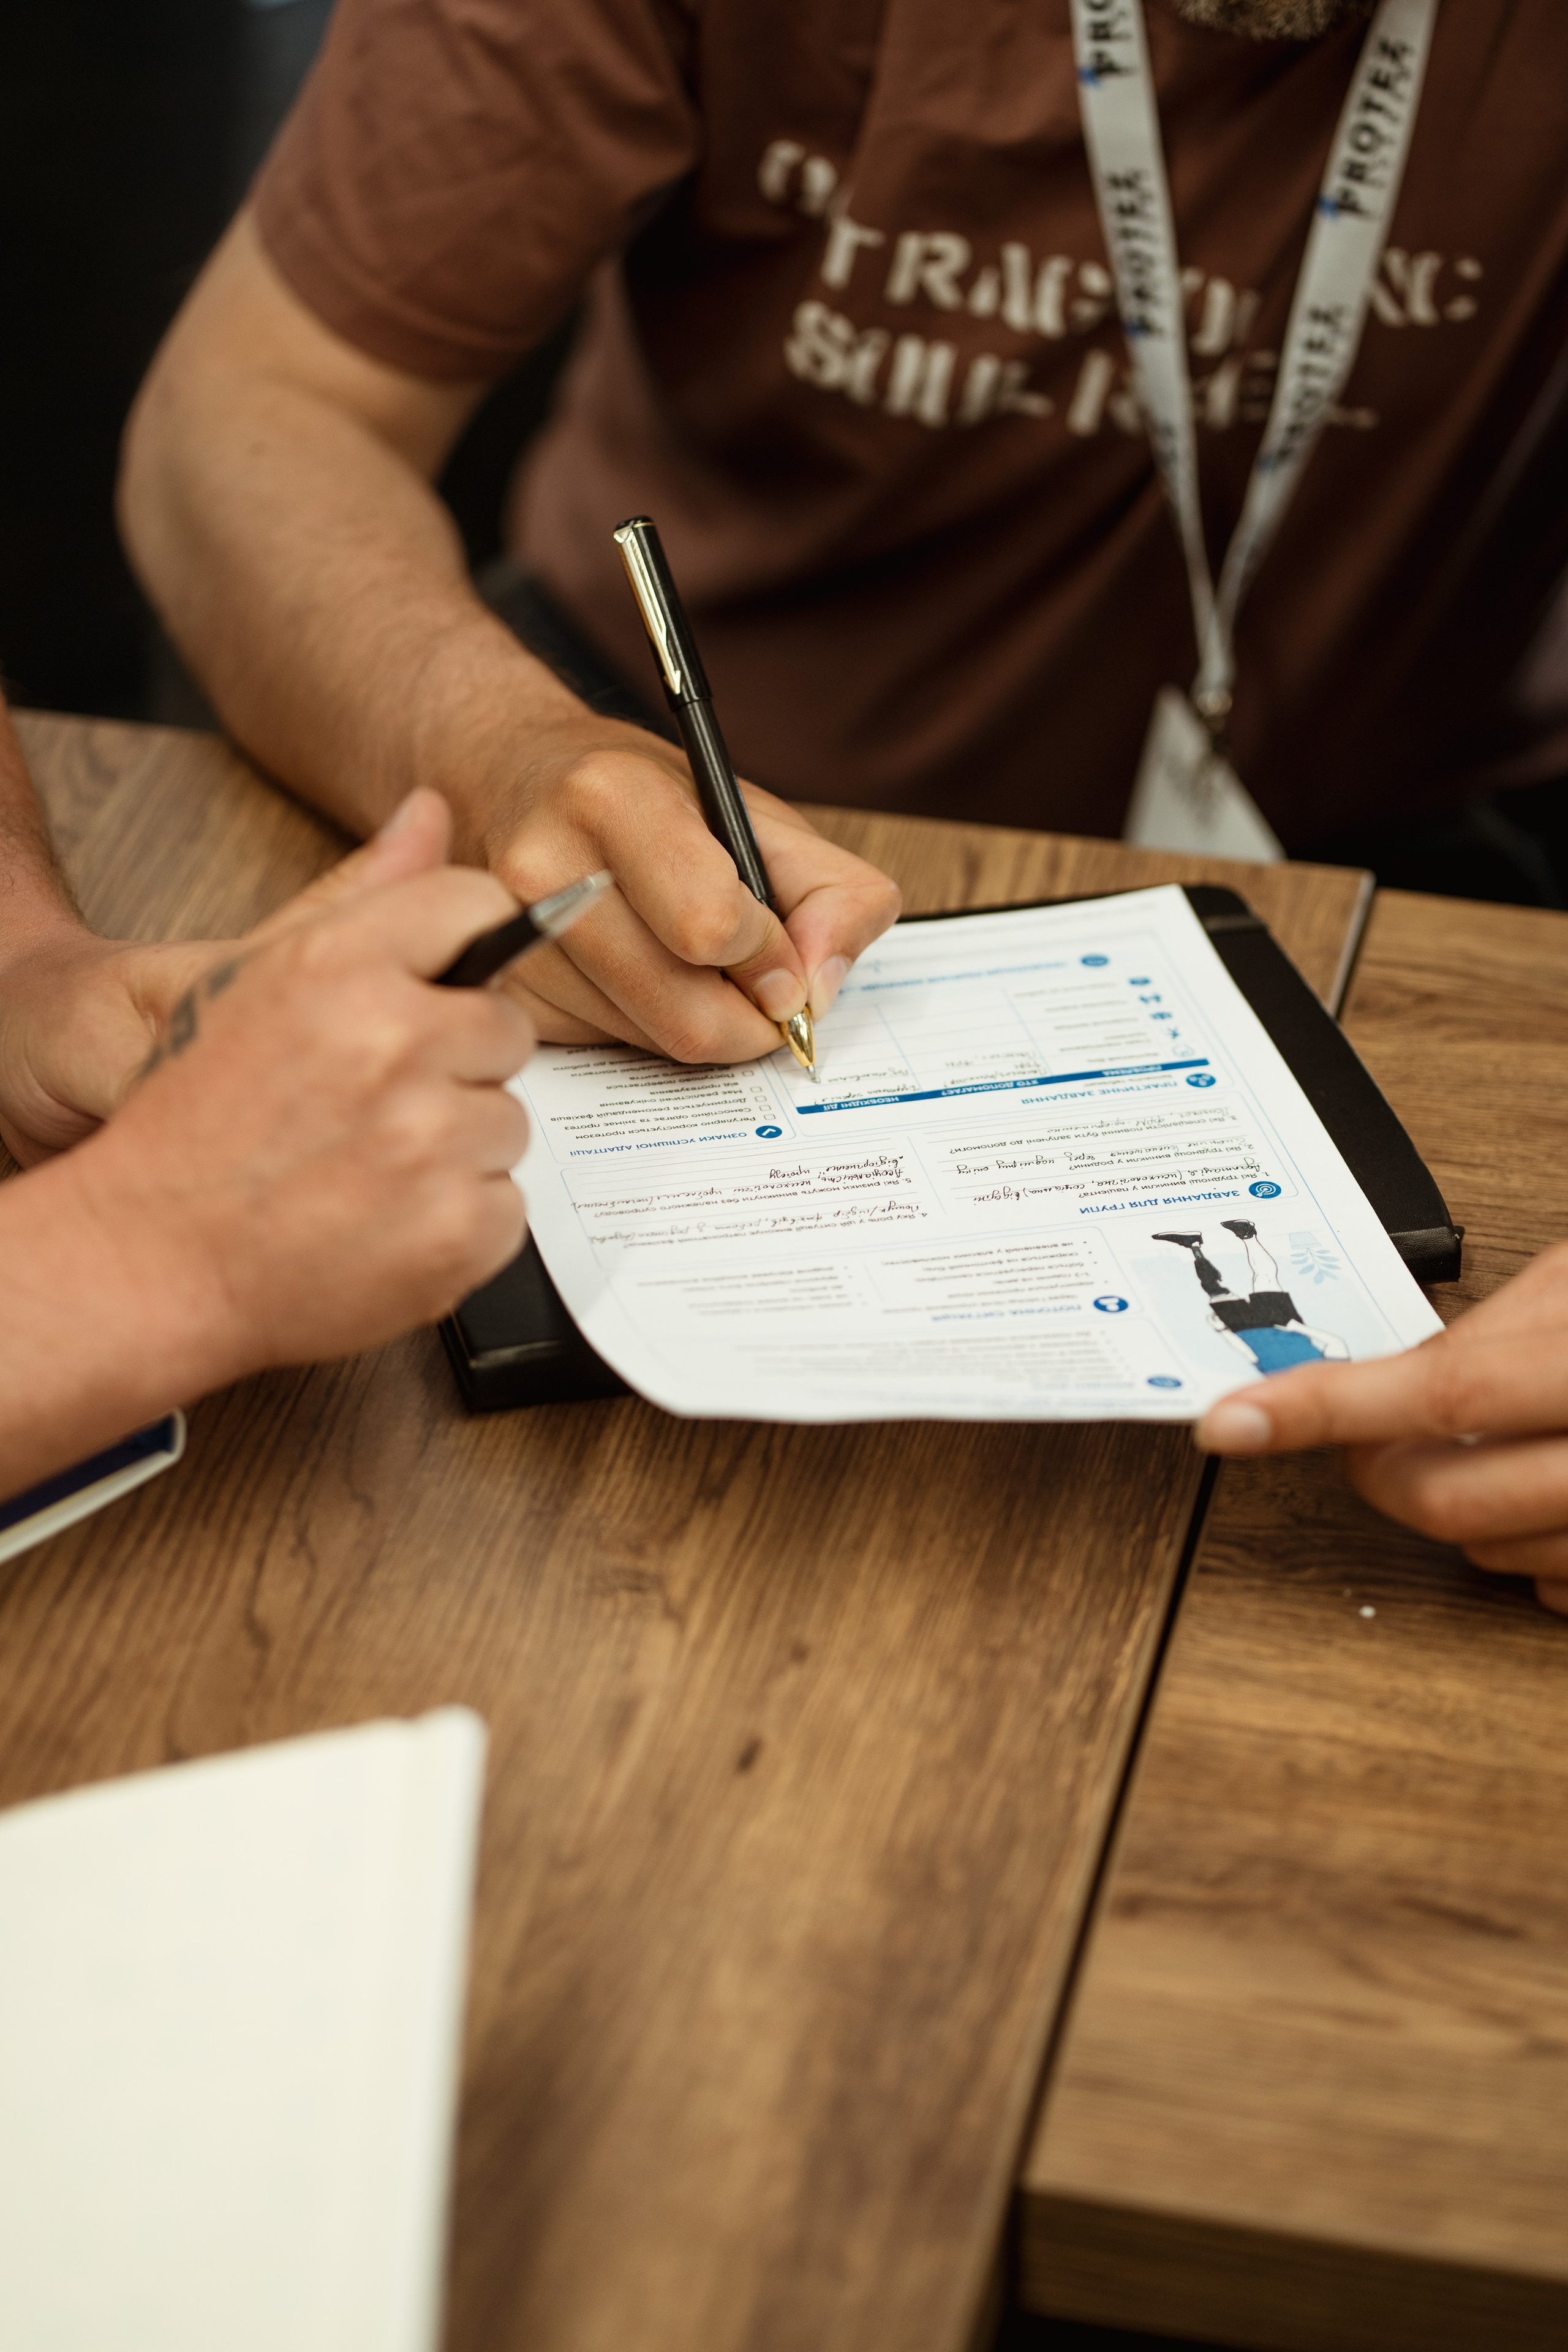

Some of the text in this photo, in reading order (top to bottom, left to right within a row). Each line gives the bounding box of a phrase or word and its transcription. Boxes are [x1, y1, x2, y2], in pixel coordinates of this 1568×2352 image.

[552, 1063, 590, 1071] роботи
[570, 1069, 617, 1077] контакти
[605, 1072, 734, 1090] Поступово повертається
[649, 1082, 721, 1095] протезування
[940, 1081, 1014, 1095] ДОПОМАГАЄ?
[1020, 1080, 1177, 1104] ПРАКТИЧНЕ ЗАВДАННЯ
[659, 1091, 718, 1102] реалістичні
[840, 1095, 899, 1109] НЕОБХІДНІ
[599, 1098, 656, 1107] очікування
[550, 1098, 746, 1123] Дотримується рекомендацій фахівців
[690, 1107, 751, 1118] Самостійно
[575, 1115, 755, 1139] Регулярно користується протезом
[1145, 1118, 1206, 1131] спеціалісти
[1074, 1131, 1098, 1139] бути
[1101, 1126, 1142, 1136] повинні
[570, 1132, 747, 1156] ОЗНАКИ УСПІШНОЇ АДАПТАЦІЇ
[1025, 1134, 1071, 1145] залучені
[949, 1142, 1006, 1154] допомоги?
[1174, 1147, 1222, 1158] труднощі
[1126, 1153, 1171, 1163] виникли
[1068, 1159, 1114, 1170] родини?
[842, 1181, 880, 1189] ризики
[1140, 1180, 1186, 1189] виникли
[1188, 1174, 1238, 1185] труднощі
[800, 1185, 840, 1194] можуть
[1078, 1186, 1129, 1198] пацієнта?
[742, 1190, 797, 1201] виникнути
[659, 1199, 717, 1210] належного
[1079, 1189, 1240, 1214] ЗАВДАННЯ ДЛЯ ГРУПИ
[593, 1206, 656, 1218] супроводу?
[750, 1226, 793, 1235] виконує
[795, 1221, 837, 1231] ситуації
[1005, 1243, 1058, 1253] впевнений
